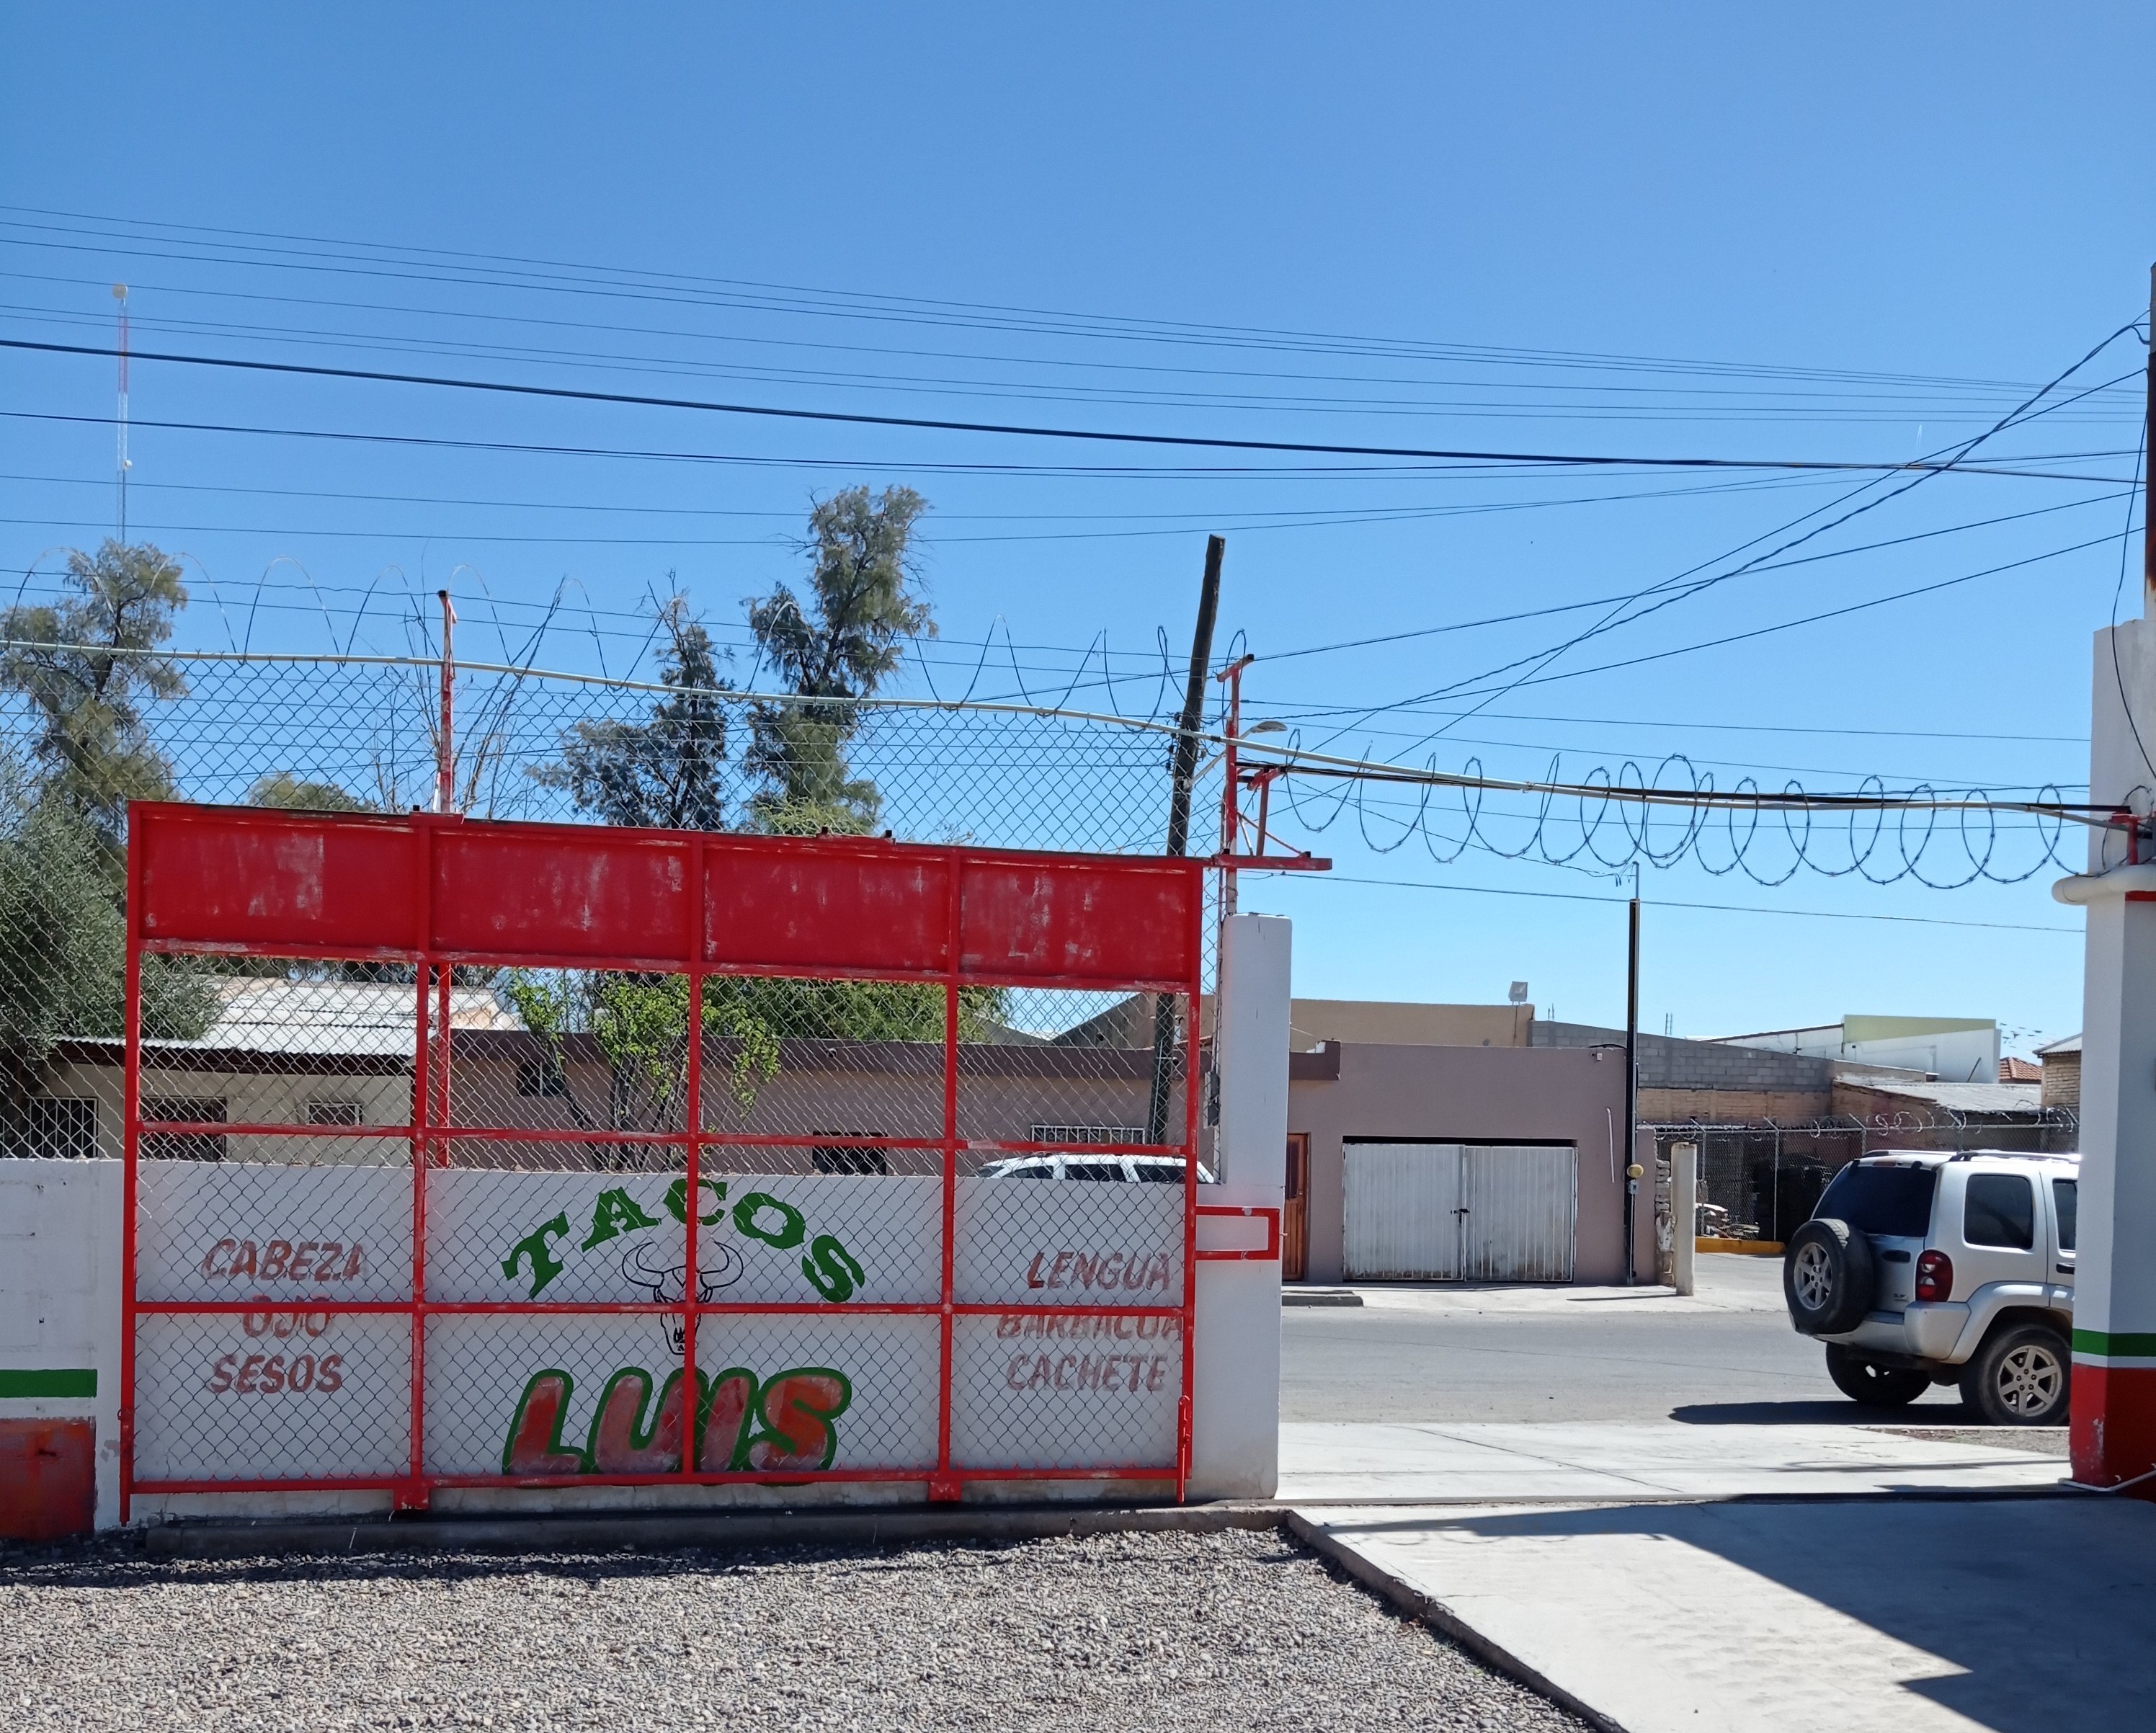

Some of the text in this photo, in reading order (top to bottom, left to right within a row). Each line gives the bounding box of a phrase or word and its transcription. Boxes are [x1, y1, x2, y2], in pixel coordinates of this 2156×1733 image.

[201, 1239, 366, 1281] CABEZA
[501, 1178, 865, 1303] TACOS
[1027, 1252, 1170, 1291] LENGUA
[243, 1295, 331, 1338] OJO
[209, 1354, 343, 1394] SESOS
[1006, 1354, 1169, 1392] CACHETE
[502, 1367, 852, 1489] LUIS
